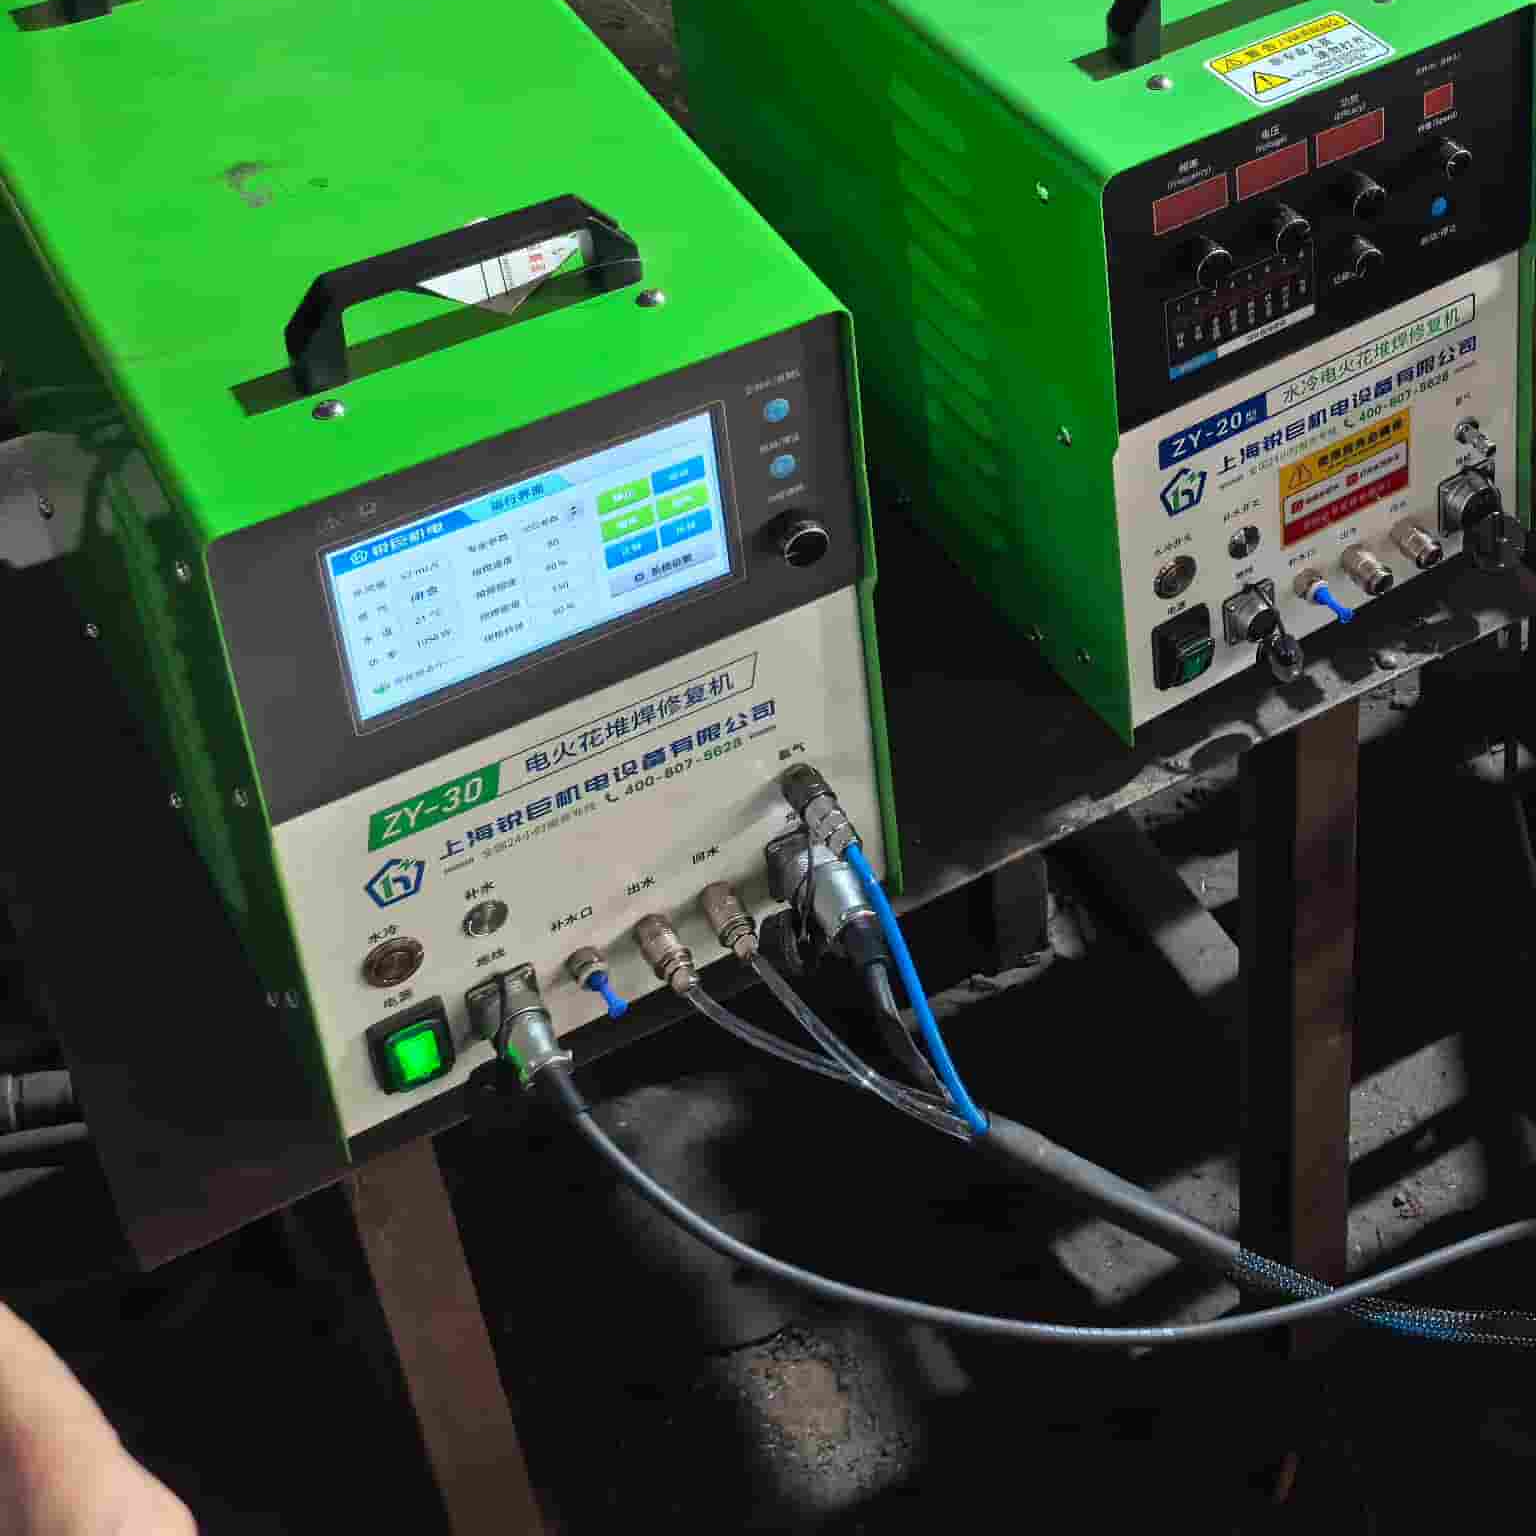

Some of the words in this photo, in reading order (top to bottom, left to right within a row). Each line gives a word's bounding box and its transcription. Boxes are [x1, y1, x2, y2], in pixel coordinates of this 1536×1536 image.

[525, 671, 735, 775] 电火花堆焊修复机
[380, 776, 484, 841] ZY-30
[439, 699, 777, 861] 上海锐巨机电设备有限公司
[550, 905, 593, 932] 补水口
[625, 877, 656, 897] 出水
